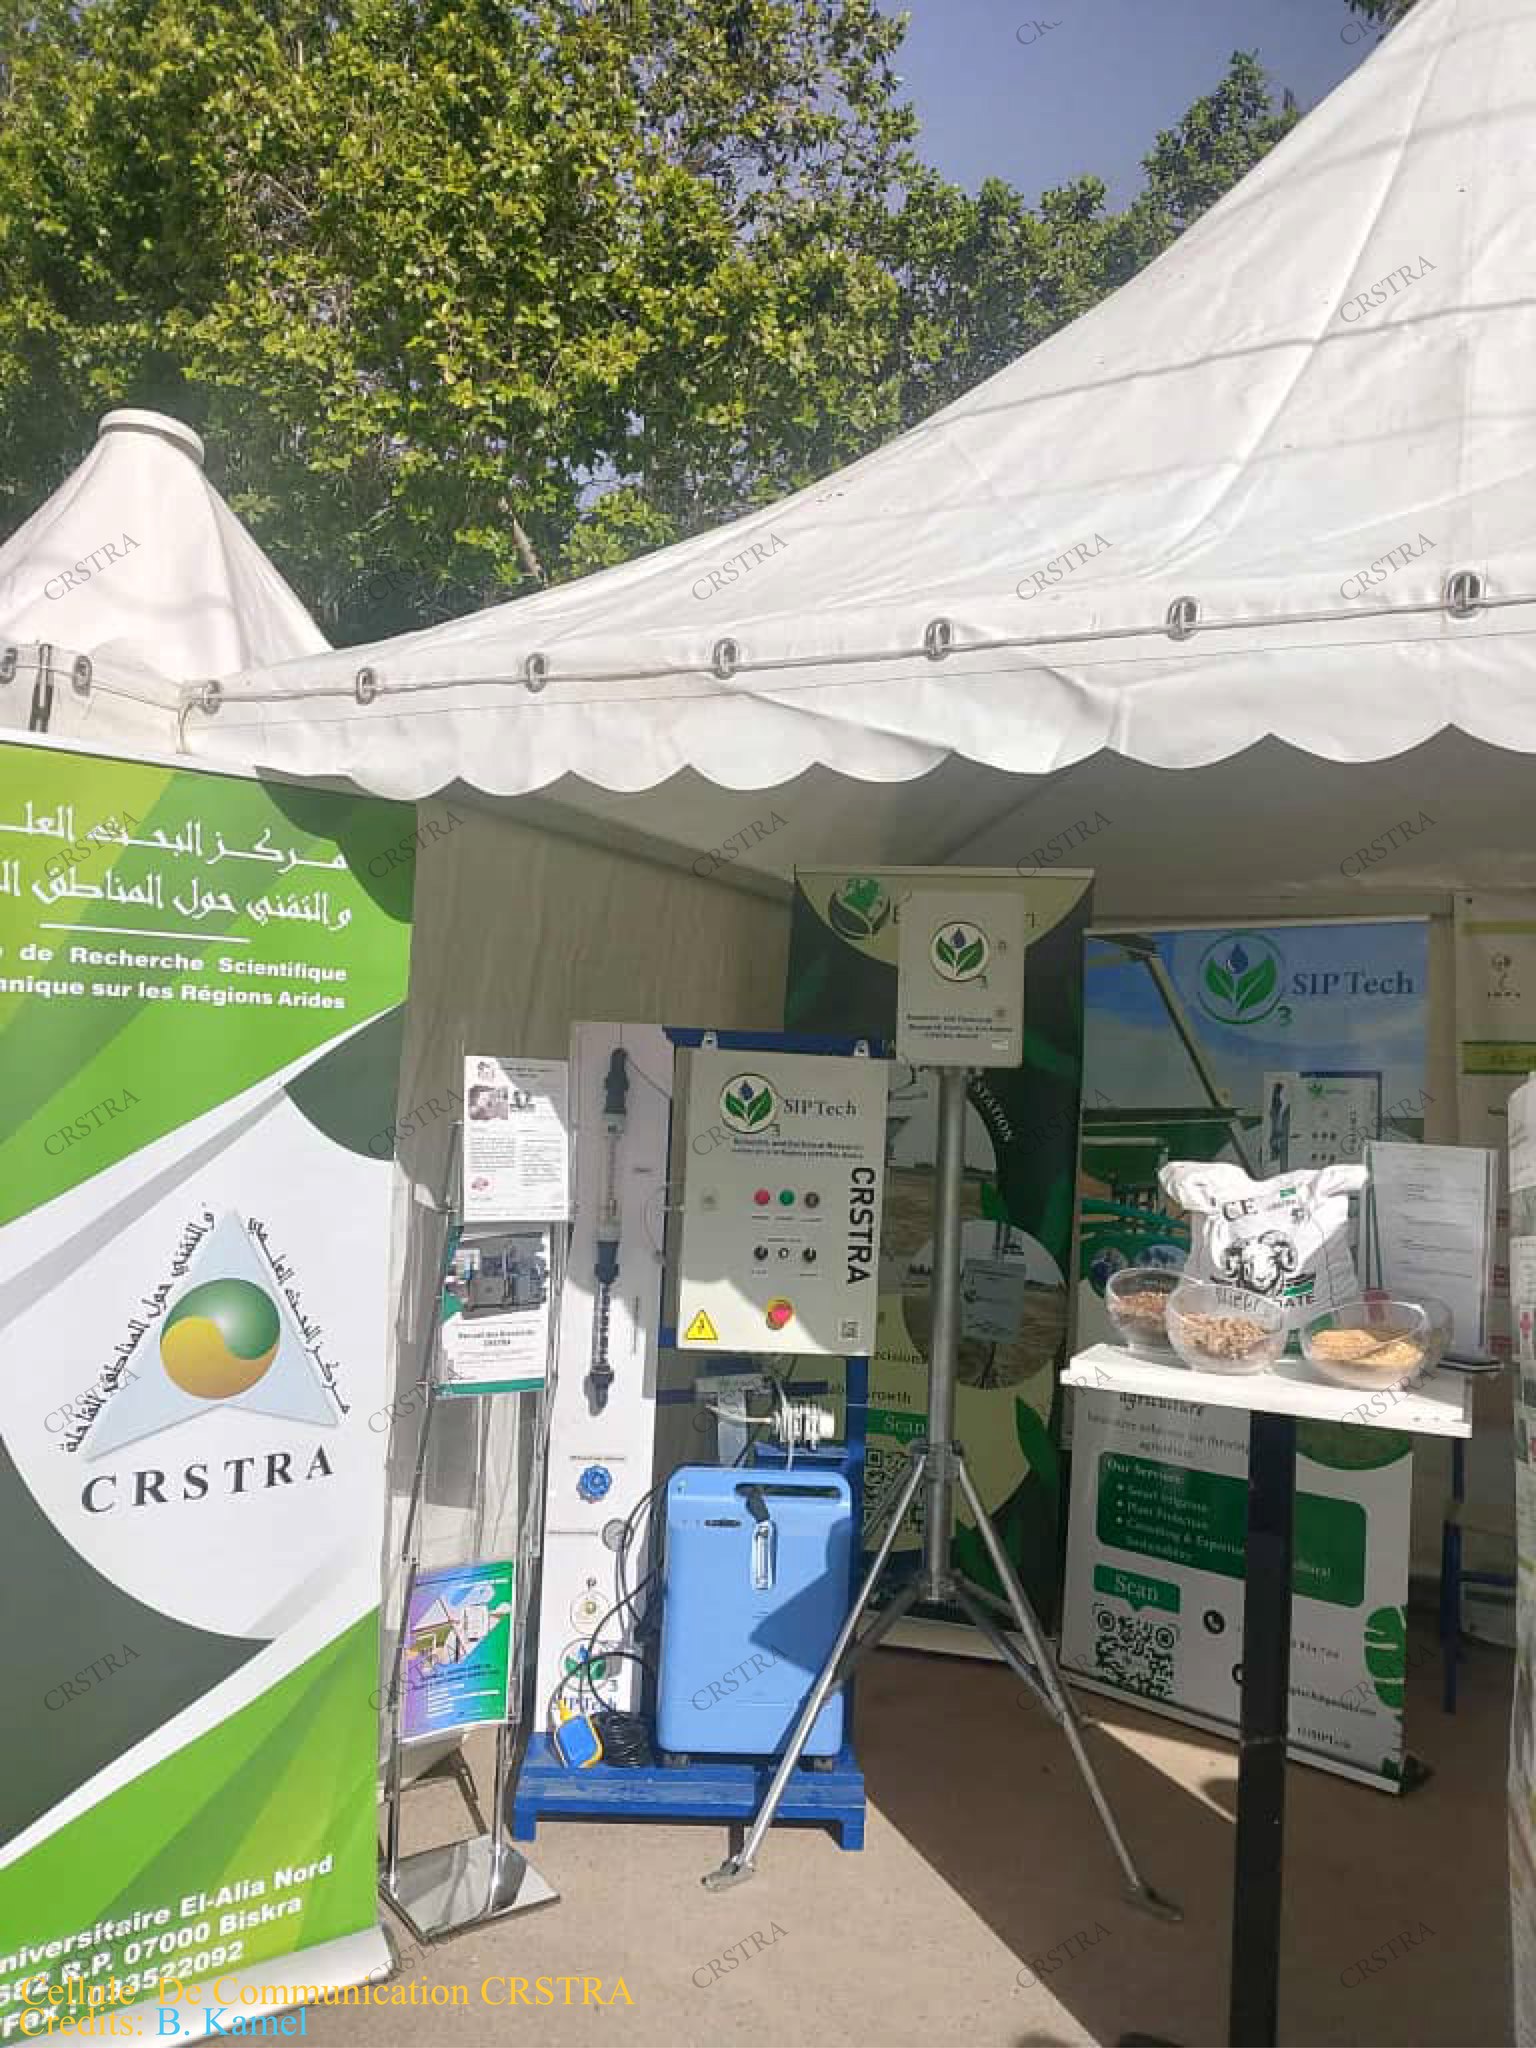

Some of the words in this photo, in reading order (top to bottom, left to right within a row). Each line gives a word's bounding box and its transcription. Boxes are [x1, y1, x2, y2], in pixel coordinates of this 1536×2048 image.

[0, 800, 75, 843] العل
[86, 815, 203, 857] البحث
[206, 827, 348, 874] مركز
[31, 864, 164, 910] المناطق
[172, 877, 239, 919] حول
[20, 944, 54, 961] de
[69, 946, 205, 971] Recherche
[217, 957, 347, 982] Scientifique
[1291, 973, 1340, 996] SIP
[1344, 970, 1415, 996] Tech
[91, 979, 132, 997] sur
[138, 981, 173, 999] les
[181, 983, 273, 1006] Régions
[278, 991, 346, 1010] Arides
[814, 1099, 857, 1118] Tech
[846, 1166, 876, 1286] CRSTRA
[80, 1444, 336, 1514] CRSTRA
[1114, 1574, 1160, 1602] Scan
[0, 1907, 171, 1974] niversitaire
[180, 1878, 266, 1918] El-Alia
[273, 1853, 335, 1891] Nord
[123, 1922, 211, 1963] 07000
[219, 1897, 302, 1936] Biskra
